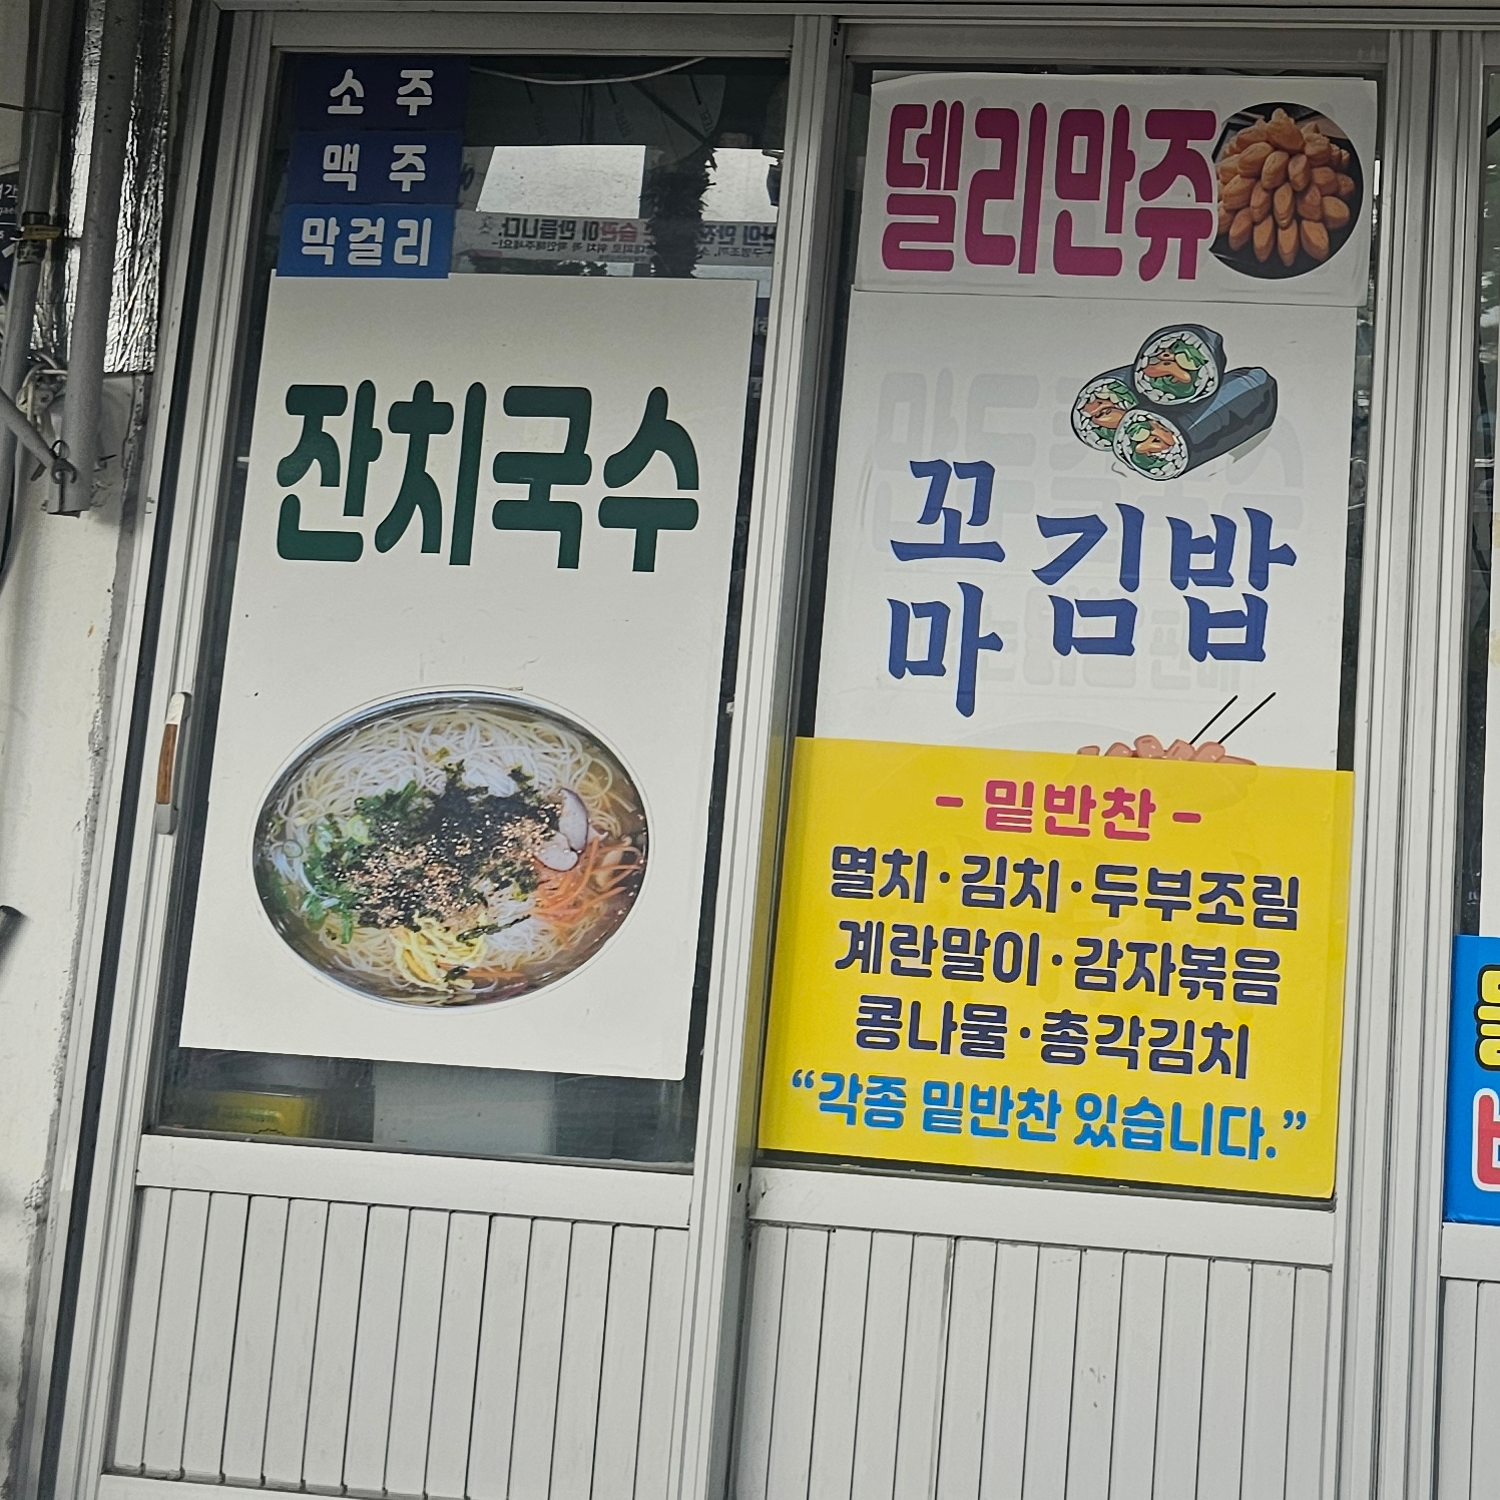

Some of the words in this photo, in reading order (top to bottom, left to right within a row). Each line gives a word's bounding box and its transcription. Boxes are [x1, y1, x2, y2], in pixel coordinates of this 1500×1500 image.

[300, 216, 432, 267] 막걸리
[881, 99, 1218, 282] 델리만쥬
[276, 379, 700, 574] 잔치국수
[1030, 502, 1298, 663] 김밥
[983, 779, 1157, 842] 밑반찬
[921, 1080, 1063, 1144] 밑반찬
